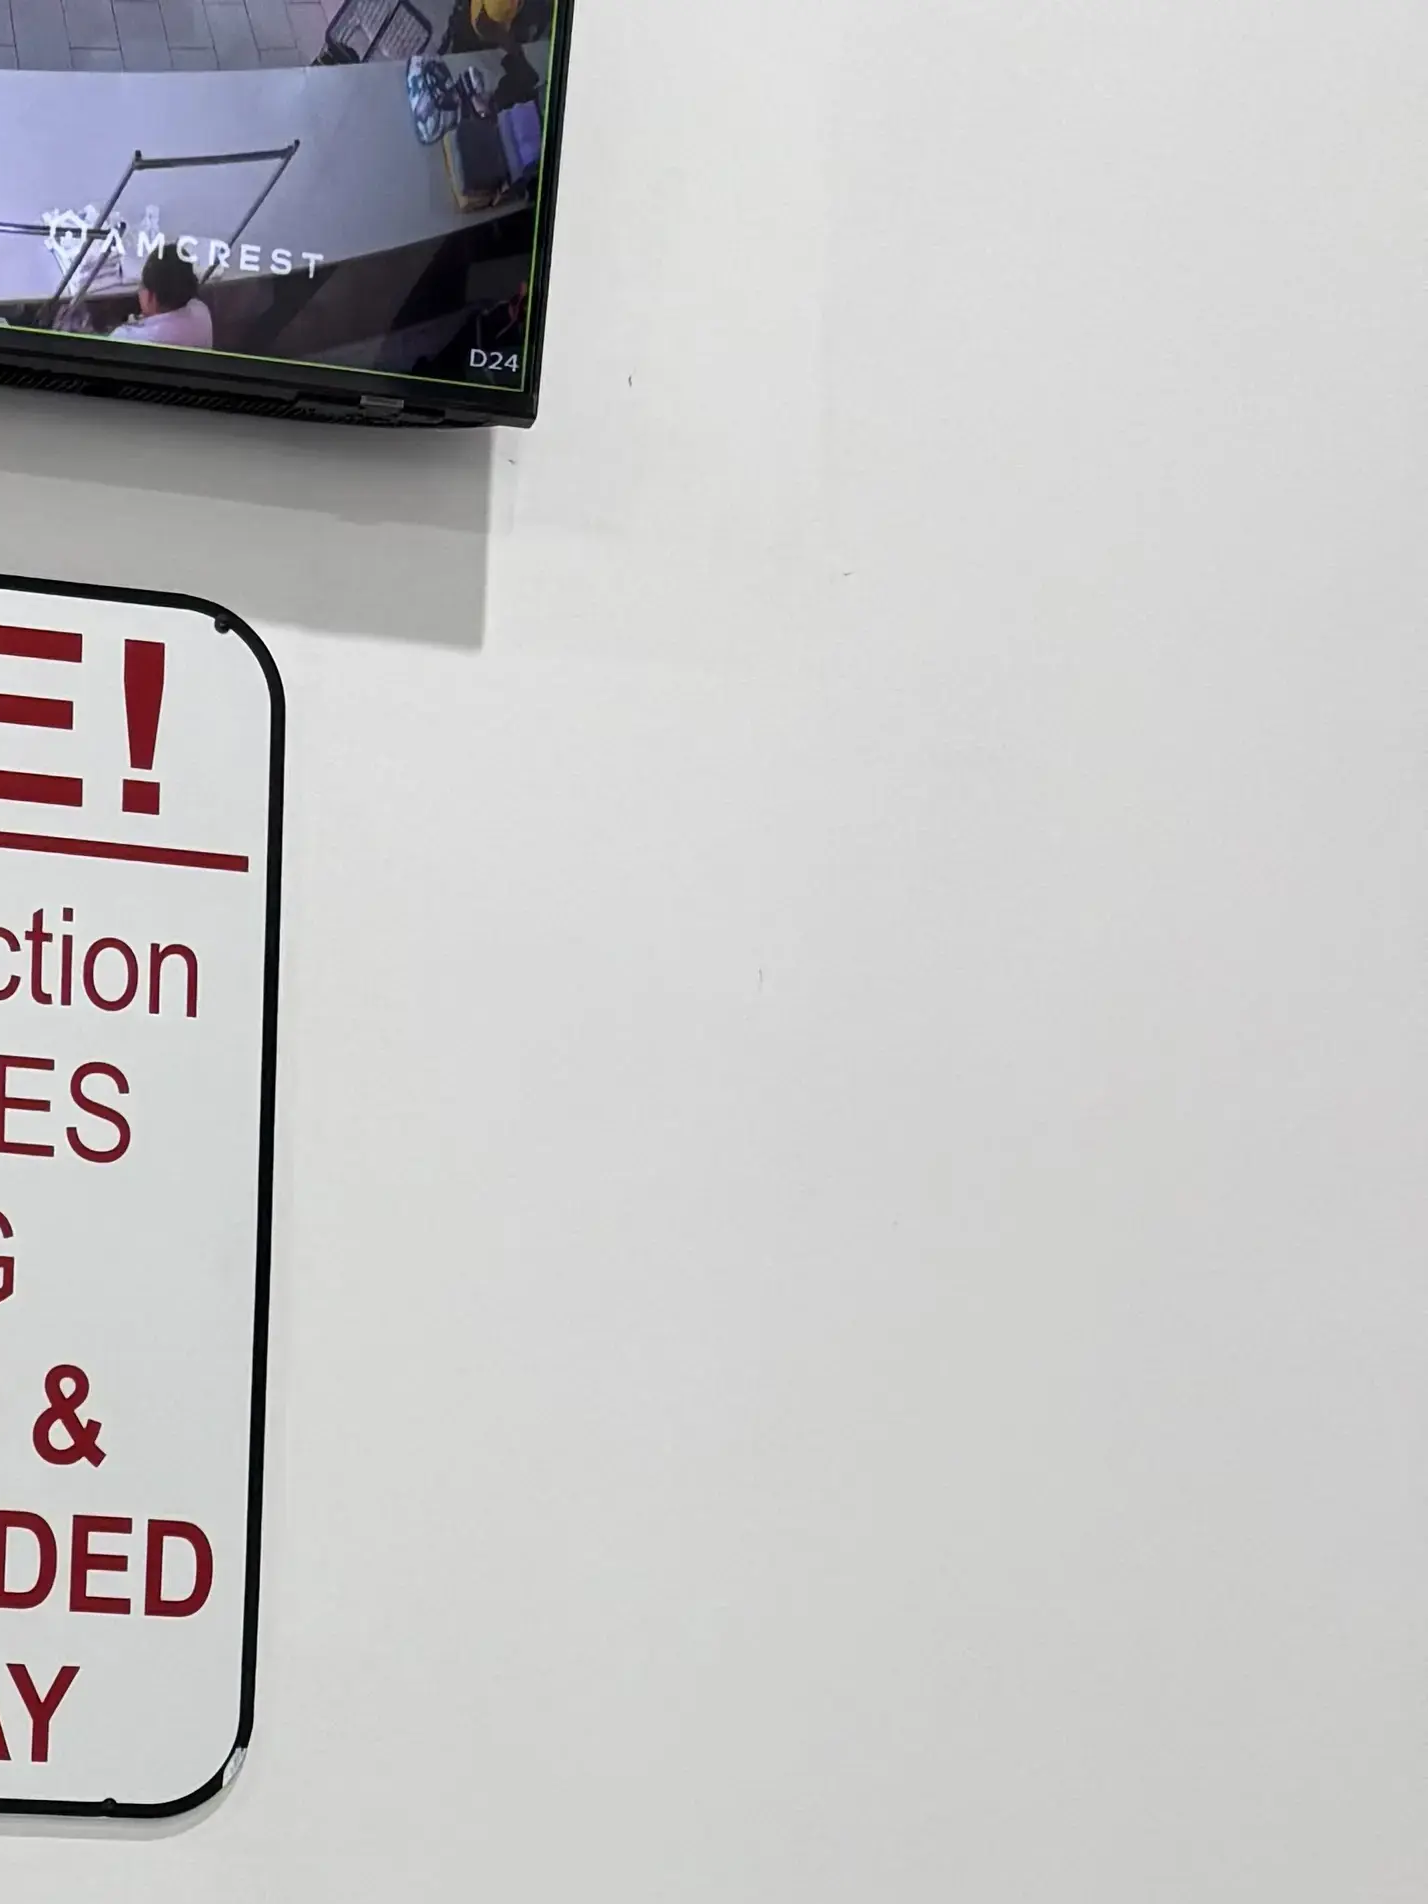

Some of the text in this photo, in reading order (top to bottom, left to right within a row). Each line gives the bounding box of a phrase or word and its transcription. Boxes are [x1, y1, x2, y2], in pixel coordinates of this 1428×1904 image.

[105, 228, 324, 279] AMCREST
[469, 348, 519, 373] D24
[33, 1366, 104, 1466] &
